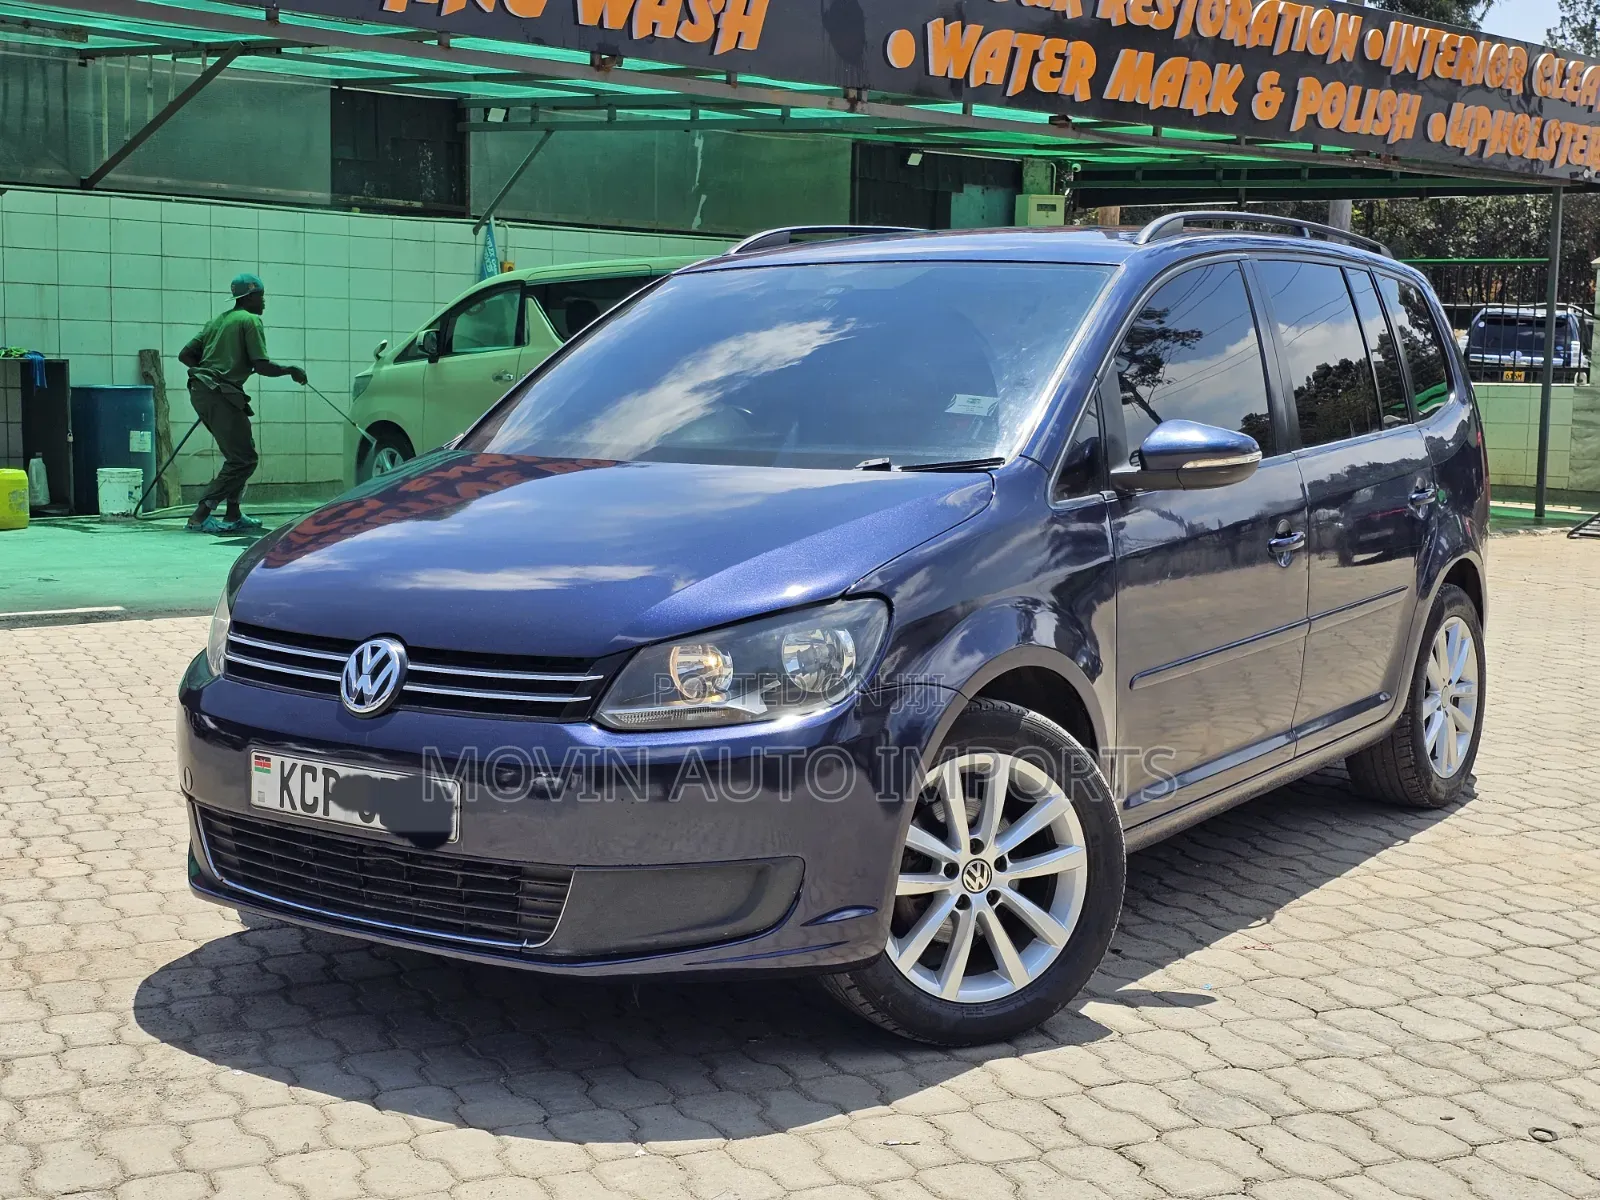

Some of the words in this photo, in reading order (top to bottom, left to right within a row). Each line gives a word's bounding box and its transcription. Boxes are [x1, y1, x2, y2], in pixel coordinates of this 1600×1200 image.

[926, 17, 1097, 103] WATER
[1102, 48, 1245, 117] MARK
[1251, 70, 1285, 121] &
[1290, 76, 1422, 145] POLISH
[1381, 20, 1528, 96] INTERIOR
[1532, 53, 1600, 113] CLEA
